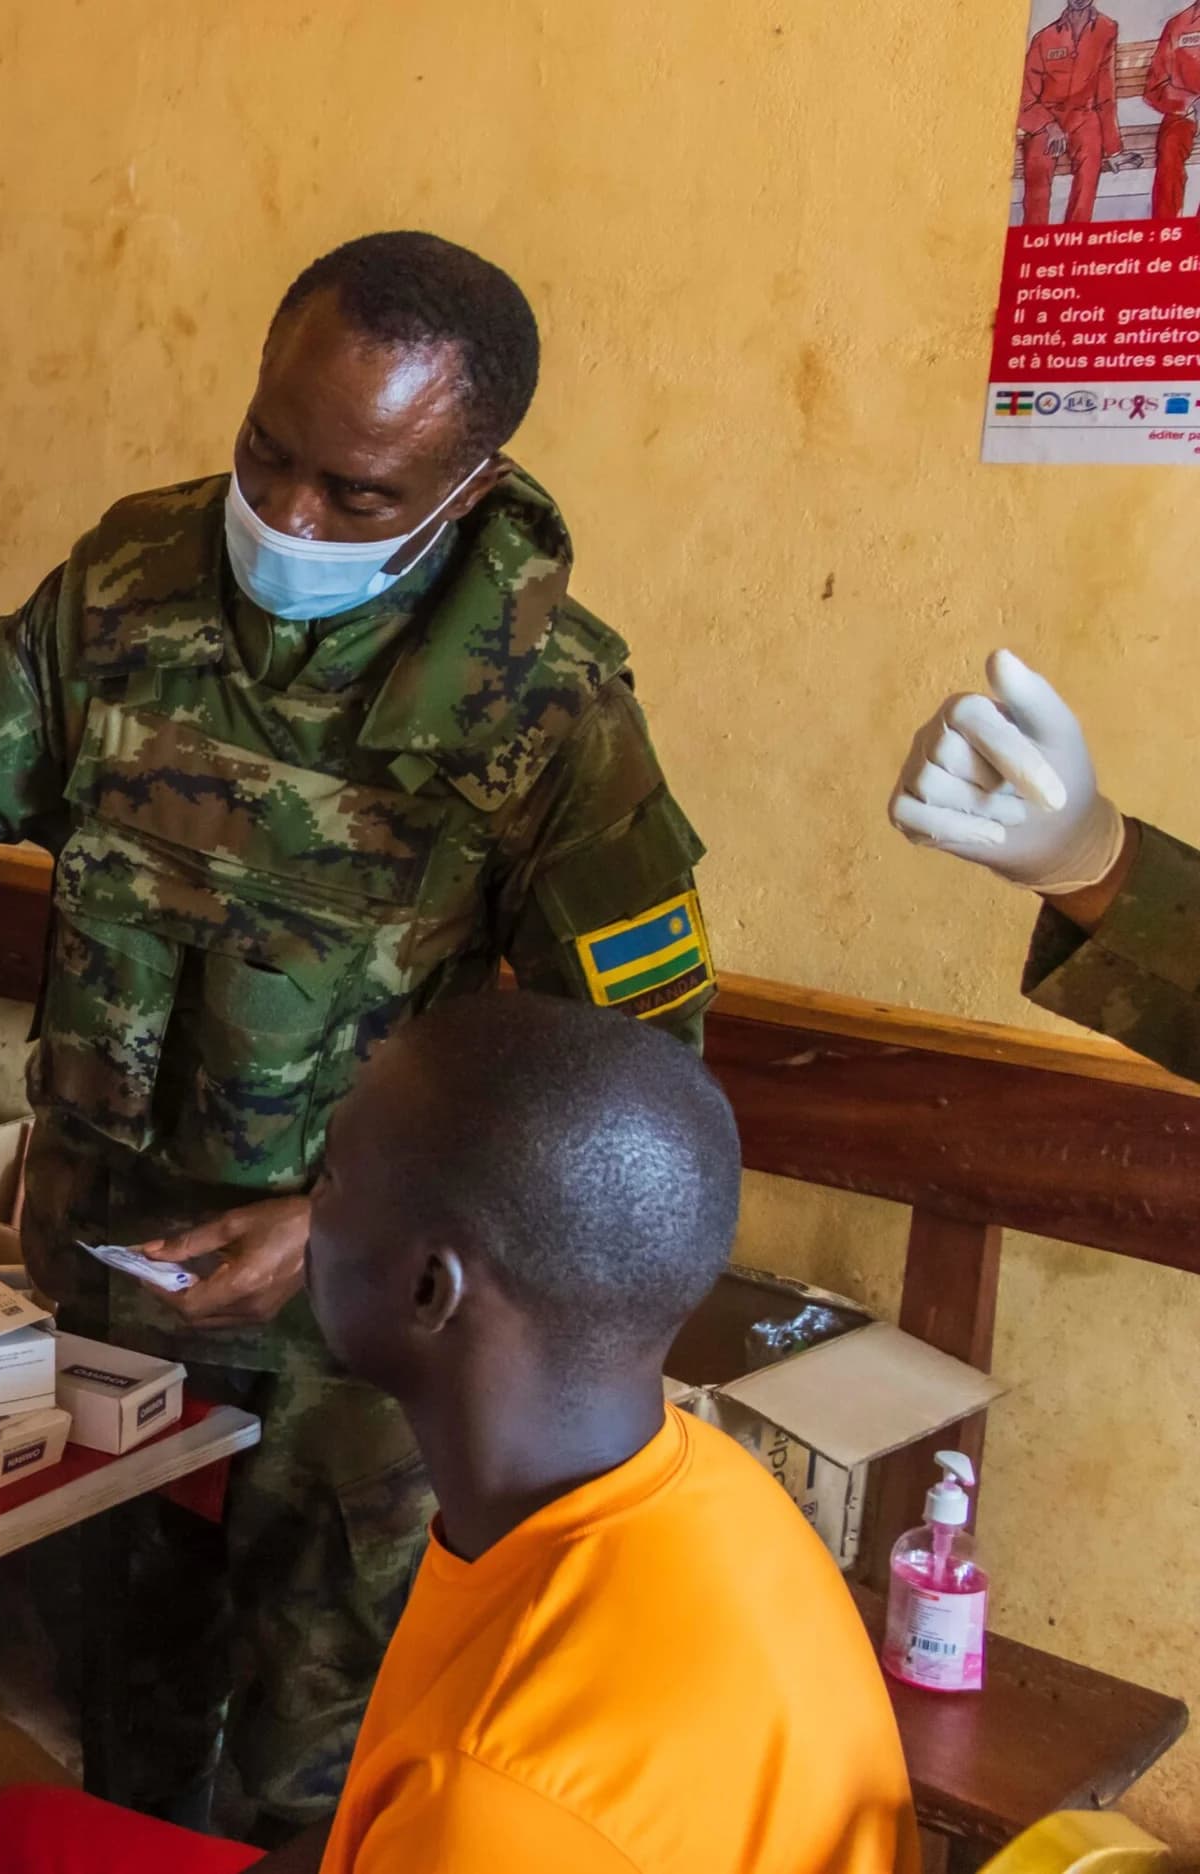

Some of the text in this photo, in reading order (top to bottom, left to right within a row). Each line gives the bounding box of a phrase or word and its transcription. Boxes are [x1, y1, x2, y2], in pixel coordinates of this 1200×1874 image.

[1023, 234, 1049, 248] Loi
[1054, 231, 1083, 246] VIH
[1087, 230, 1143, 246] article
[1160, 227, 1182, 242] 65
[1035, 265, 1064, 278] est
[1071, 259, 1140, 276] interdit
[1146, 257, 1173, 273] de
[1016, 285, 1081, 304] prison.
[1036, 312, 1048, 323] a
[1060, 307, 1105, 323] droit
[1011, 330, 1066, 347] santé,
[1072, 333, 1107, 345] aux
[1007, 355, 1026, 369] et
[1030, 353, 1041, 368] à
[1046, 354, 1088, 368] tous
[1093, 353, 1156, 368] autres
[1148, 429, 1184, 441] éditer
